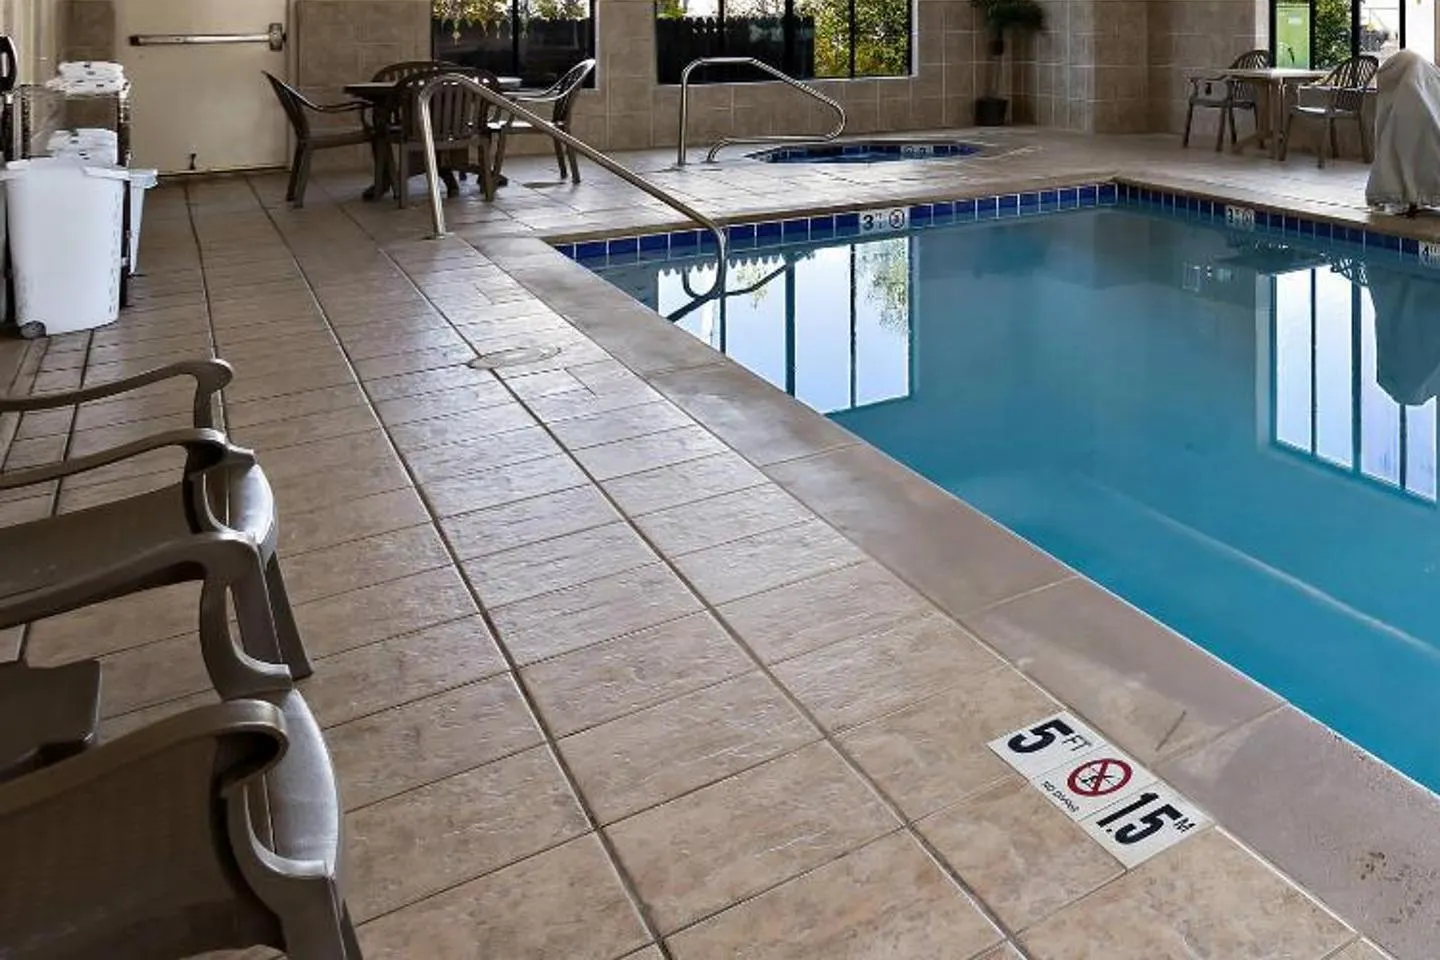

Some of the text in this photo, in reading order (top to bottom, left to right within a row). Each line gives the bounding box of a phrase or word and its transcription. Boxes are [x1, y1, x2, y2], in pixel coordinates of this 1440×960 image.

[1008, 719, 1092, 753] 5 FT
[1096, 793, 1183, 844] 1.5
